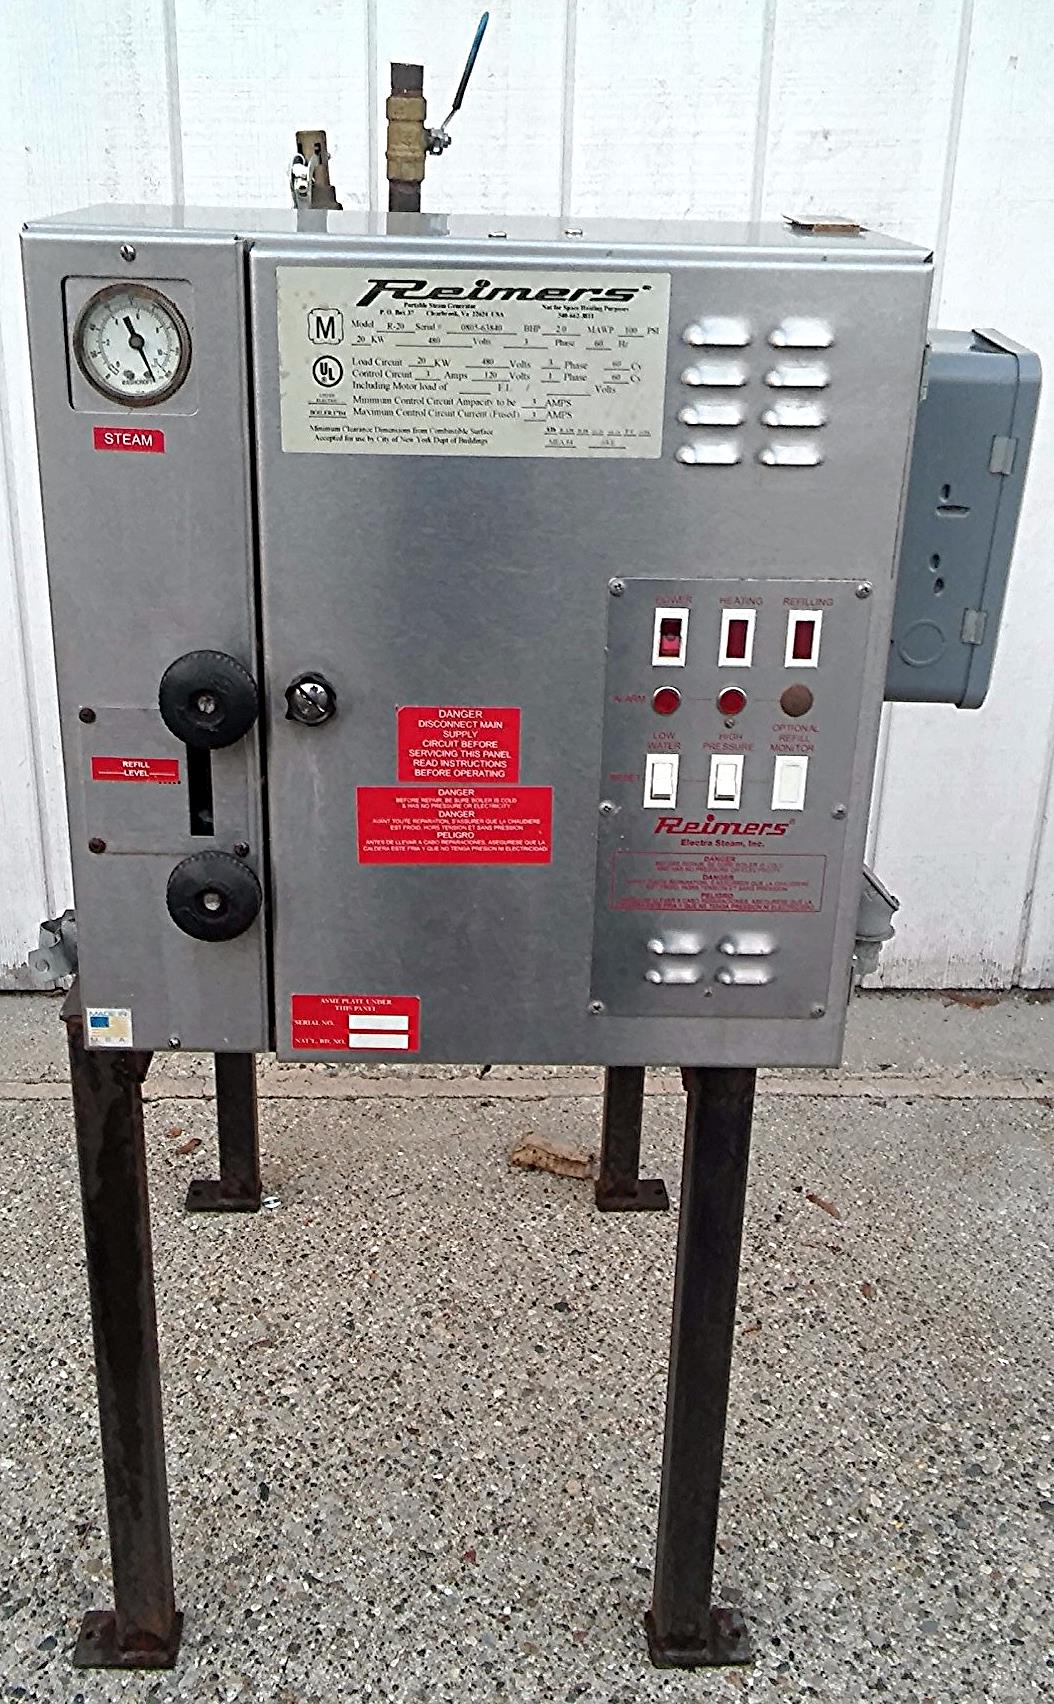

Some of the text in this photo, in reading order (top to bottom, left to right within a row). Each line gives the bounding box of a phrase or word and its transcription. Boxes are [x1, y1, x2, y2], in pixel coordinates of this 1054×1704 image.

[356, 279, 639, 306] Reimers
[316, 316, 335, 339] M
[351, 320, 660, 335] Model R-20 Serial BHP MAWP 100 PSI
[371, 335, 384, 343] KW
[472, 337, 491, 345] Volts
[555, 339, 575, 347] Phase
[352, 357, 373, 366] Load
[374, 357, 403, 367] Circuit
[417, 356, 426, 364] 20
[434, 358, 452, 367] KW
[481, 357, 494, 365] 480
[509, 359, 531, 369] Volts
[564, 360, 588, 370] Phase
[352, 369, 383, 379] Control
[384, 370, 412, 379] Circuit
[444, 371, 468, 381] Amps
[484, 371, 498, 379] 120
[509, 371, 531, 380] Volts
[564, 373, 588, 382] Phase
[352, 380, 616, 394] Including Motor load of Volts
[352, 395, 572, 408] Minimum Control Circuit Ampacity to be AMPS
[353, 407, 572, 419] Maximum Control Circuit Current (Fused) AMPS
[309, 424, 340, 432] Minimum
[104, 433, 153, 447] STEAM
[315, 434, 343, 442] Accepted
[458, 437, 488, 445] Buildings
[655, 596, 693, 604] POWER
[719, 596, 764, 606] HEATING
[783, 597, 833, 606] REFILLING
[438, 709, 483, 718] DANGER
[418, 720, 503, 729] DISCONNECT MAIN
[772, 724, 819, 732] OPTIONAL
[443, 730, 478, 738] SUPPLY
[652, 732, 676, 740] LOW
[422, 740, 498, 749] CIRCUIT BEFORE
[647, 741, 681, 749] WATER
[703, 741, 754, 750] PRESSURE
[770, 744, 815, 752] MONITOR
[408, 749, 511, 759] SERVICING THIS PANEL
[122, 760, 150, 768] REFILL
[413, 759, 507, 768] READ INSTRUCTIONS
[123, 769, 150, 777] LEVEL
[414, 769, 505, 778] BEFORE OPERATING
[438, 810, 475, 818] DANGER
[654, 814, 789, 836] Reimers
[436, 831, 475, 839] PELIGRO
[680, 838, 765, 848] Electra Steam, Inc.
